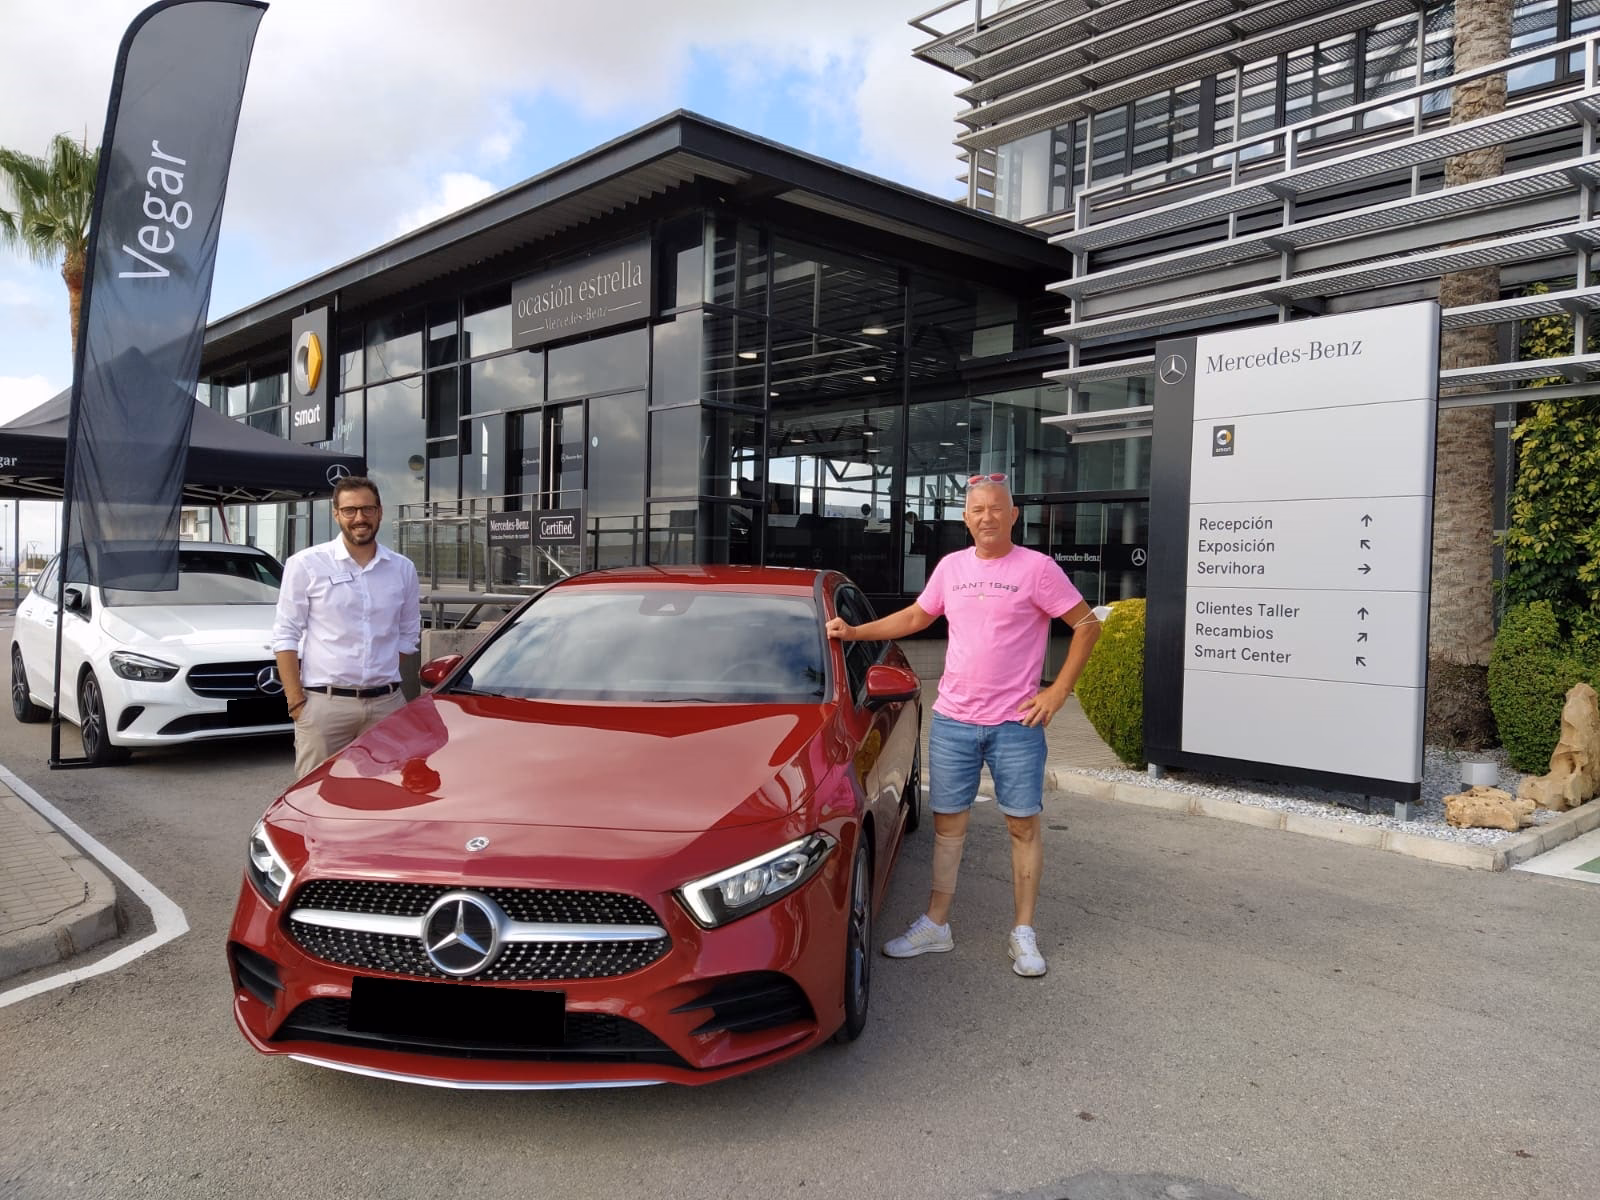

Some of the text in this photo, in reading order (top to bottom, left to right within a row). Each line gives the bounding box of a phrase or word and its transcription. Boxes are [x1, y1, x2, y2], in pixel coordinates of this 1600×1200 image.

[118, 139, 193, 279] Vegar
[517, 260, 643, 320] ocasión estrella
[545, 305, 608, 331] Mercedes-Benz
[1206, 339, 1363, 374] Mercedes-Benz
[294, 404, 320, 427] smart
[541, 520, 573, 536] Certified
[1199, 516, 1273, 533] Recepción
[1198, 539, 1275, 555] Exposición
[1197, 561, 1265, 576] Servihora
[1195, 601, 1300, 618] Clientes Taller
[1195, 623, 1274, 640] Recambios
[1194, 645, 1292, 664] Smart Center
